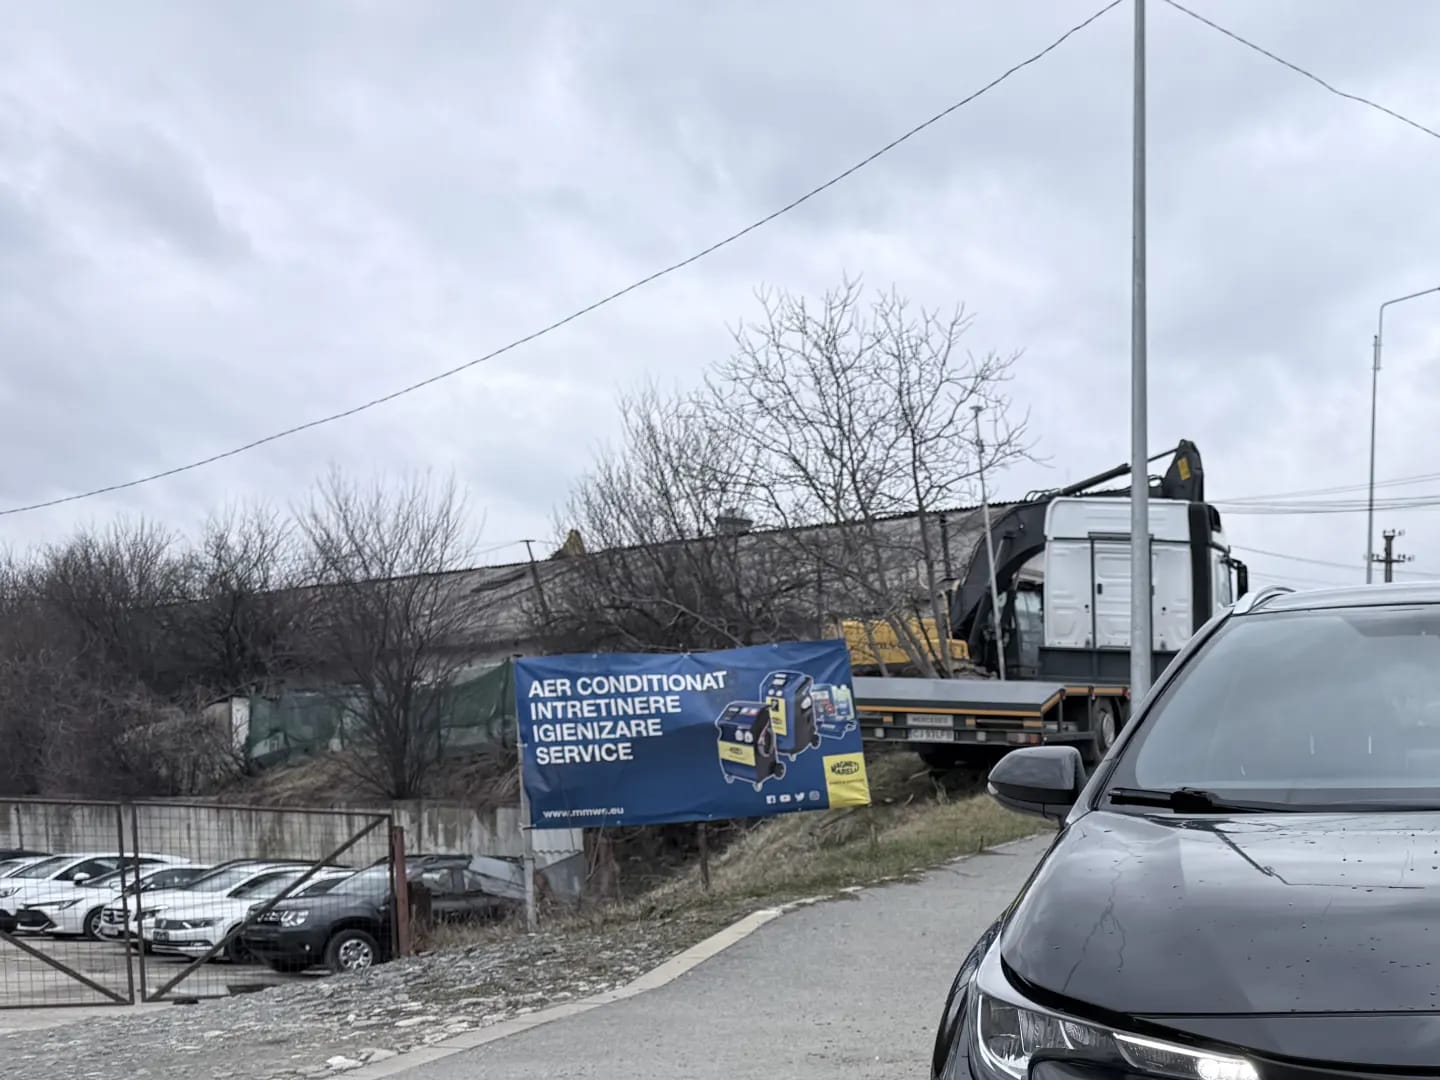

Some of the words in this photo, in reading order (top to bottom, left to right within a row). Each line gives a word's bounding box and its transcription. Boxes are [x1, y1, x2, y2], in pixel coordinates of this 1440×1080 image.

[528, 678, 572, 698] AER
[576, 671, 727, 696] CONDITIONAT
[530, 695, 682, 720] INTRETINERE
[533, 718, 664, 742] IGIENIZARE
[535, 742, 634, 765] SERVICE
